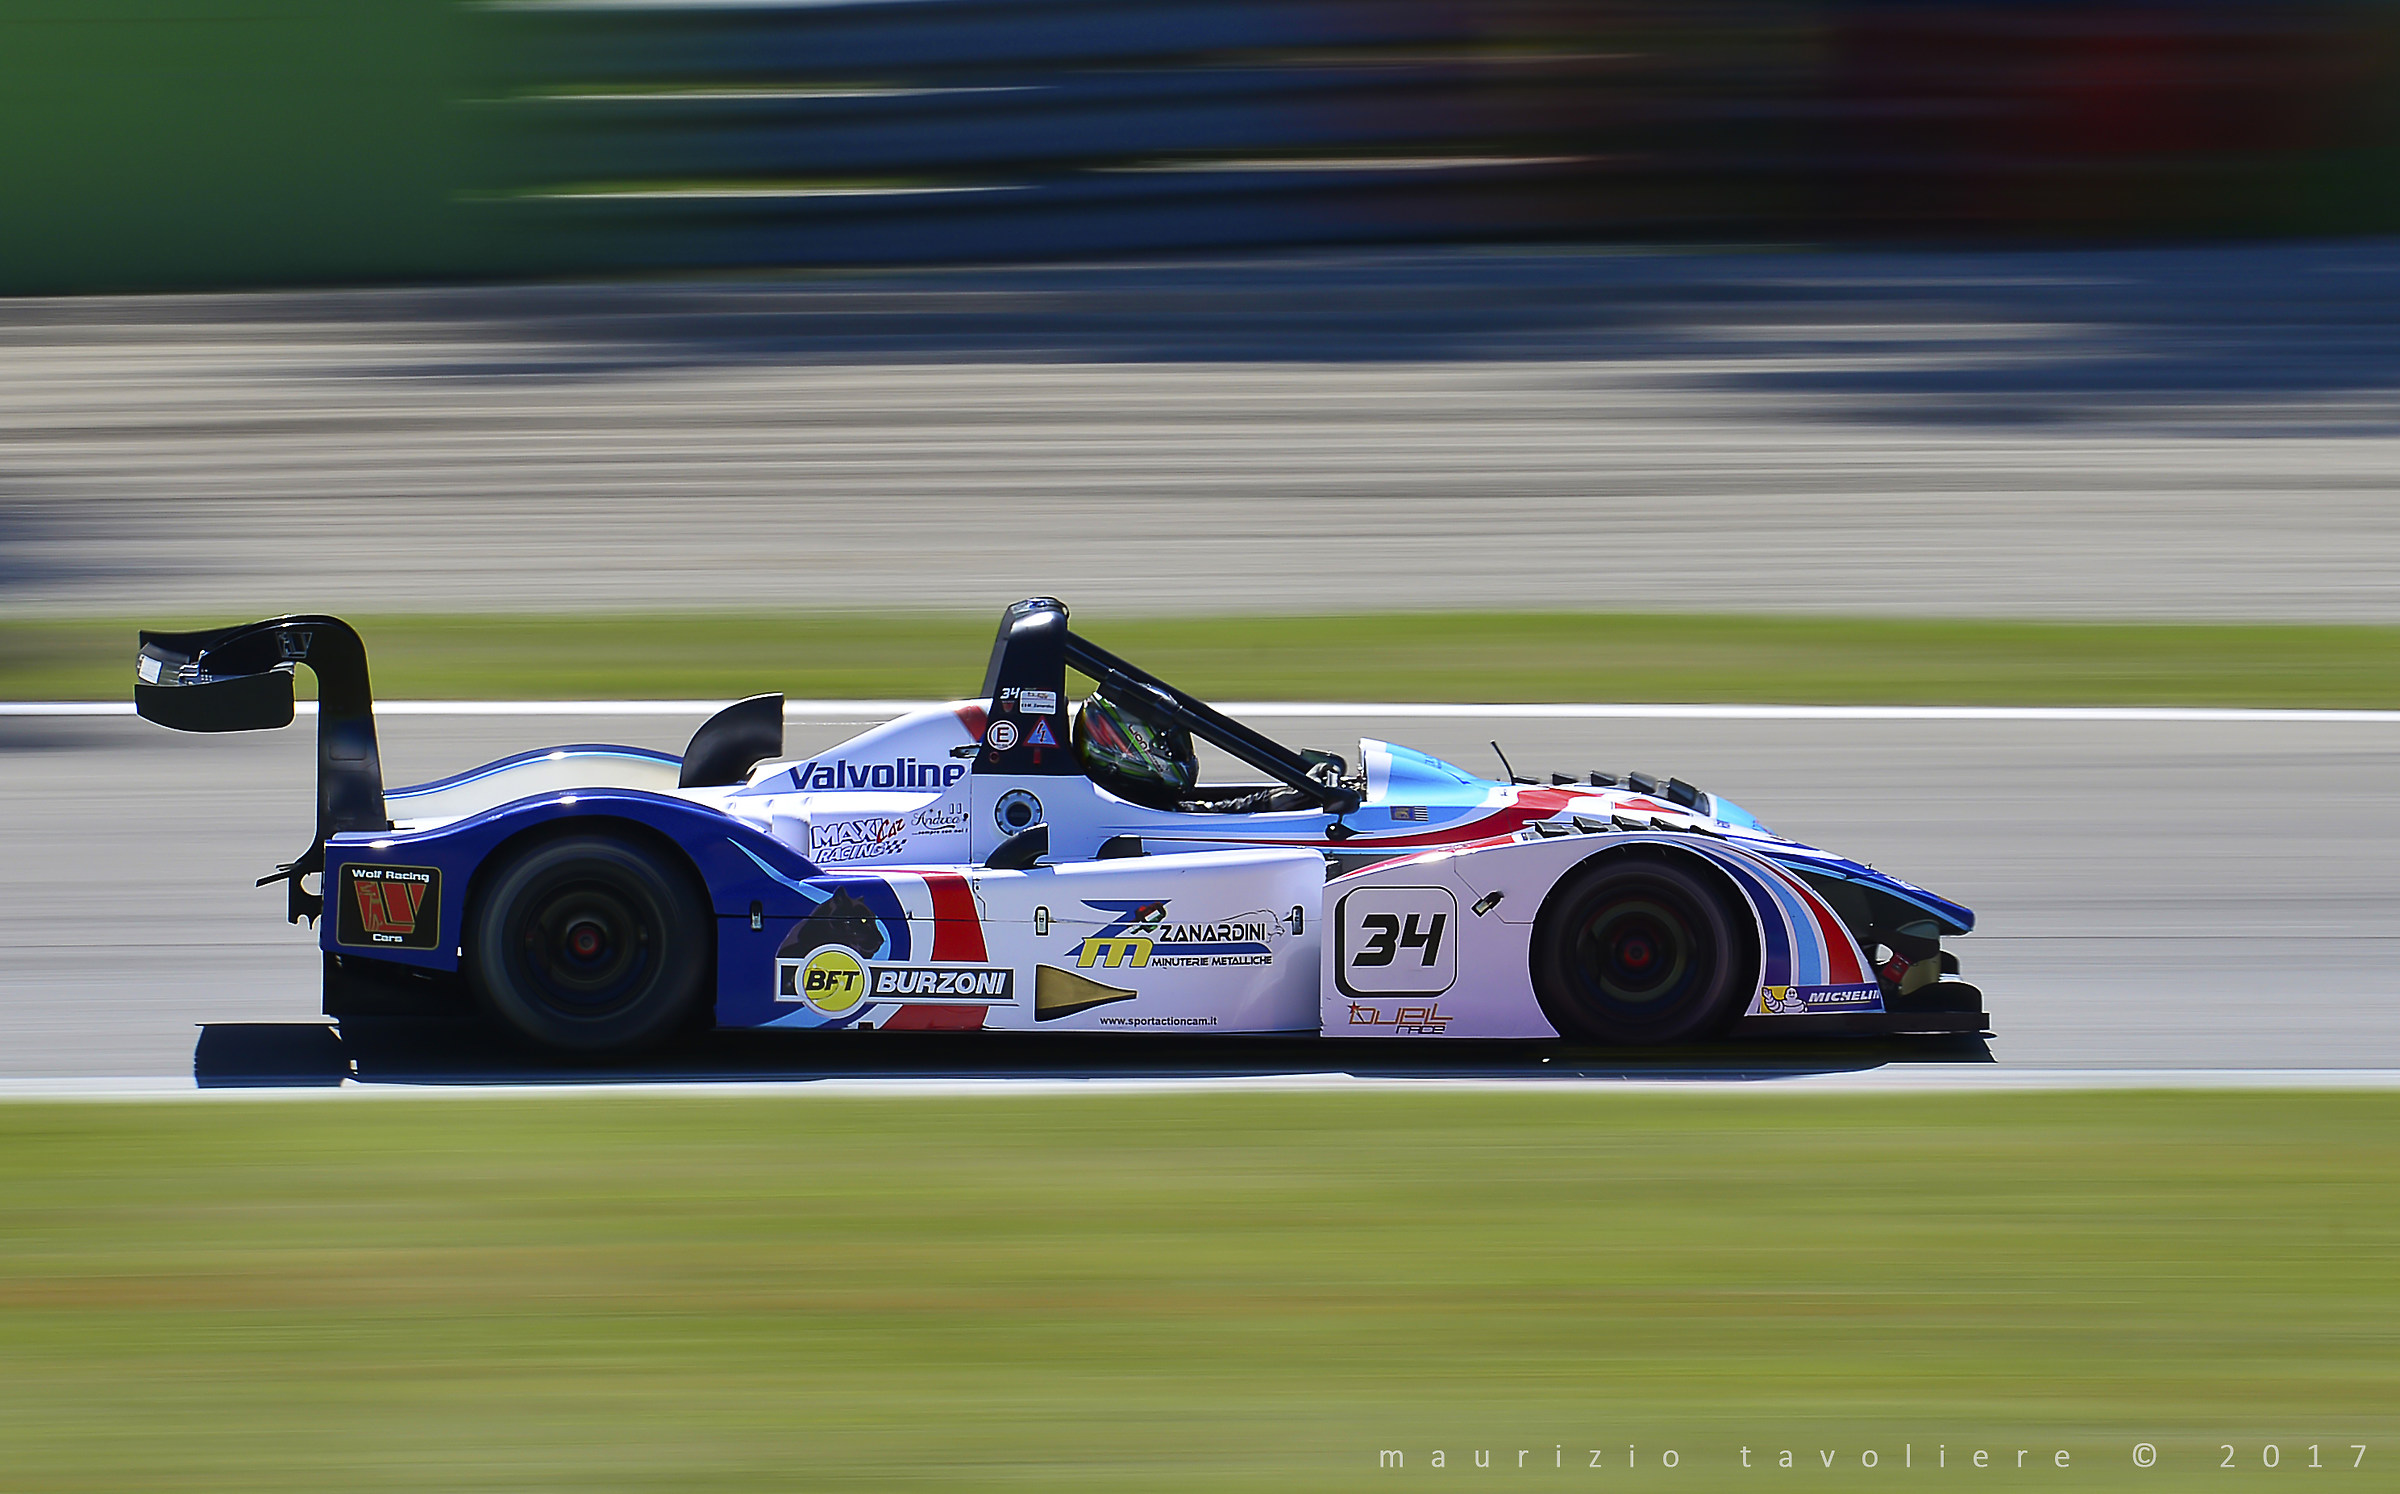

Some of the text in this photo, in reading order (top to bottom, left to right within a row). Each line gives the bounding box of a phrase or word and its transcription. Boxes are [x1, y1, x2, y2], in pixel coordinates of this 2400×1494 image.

[1000, 687, 1021, 700] 34
[996, 726, 1010, 743] E
[788, 757, 966, 791] Valvoline
[811, 817, 884, 850] MAXI
[815, 842, 886, 864] RACING
[351, 869, 430, 883] Wolf Racing
[372, 933, 404, 943] Cars
[1158, 923, 1267, 943] ZANARDINI
[1351, 913, 1447, 968] 34
[1151, 955, 1273, 968] MINUTERIE METALLICHE
[805, 969, 1007, 995] BFT BURZONI
[1099, 1015, 1218, 1027] www.sportactioncam.it
